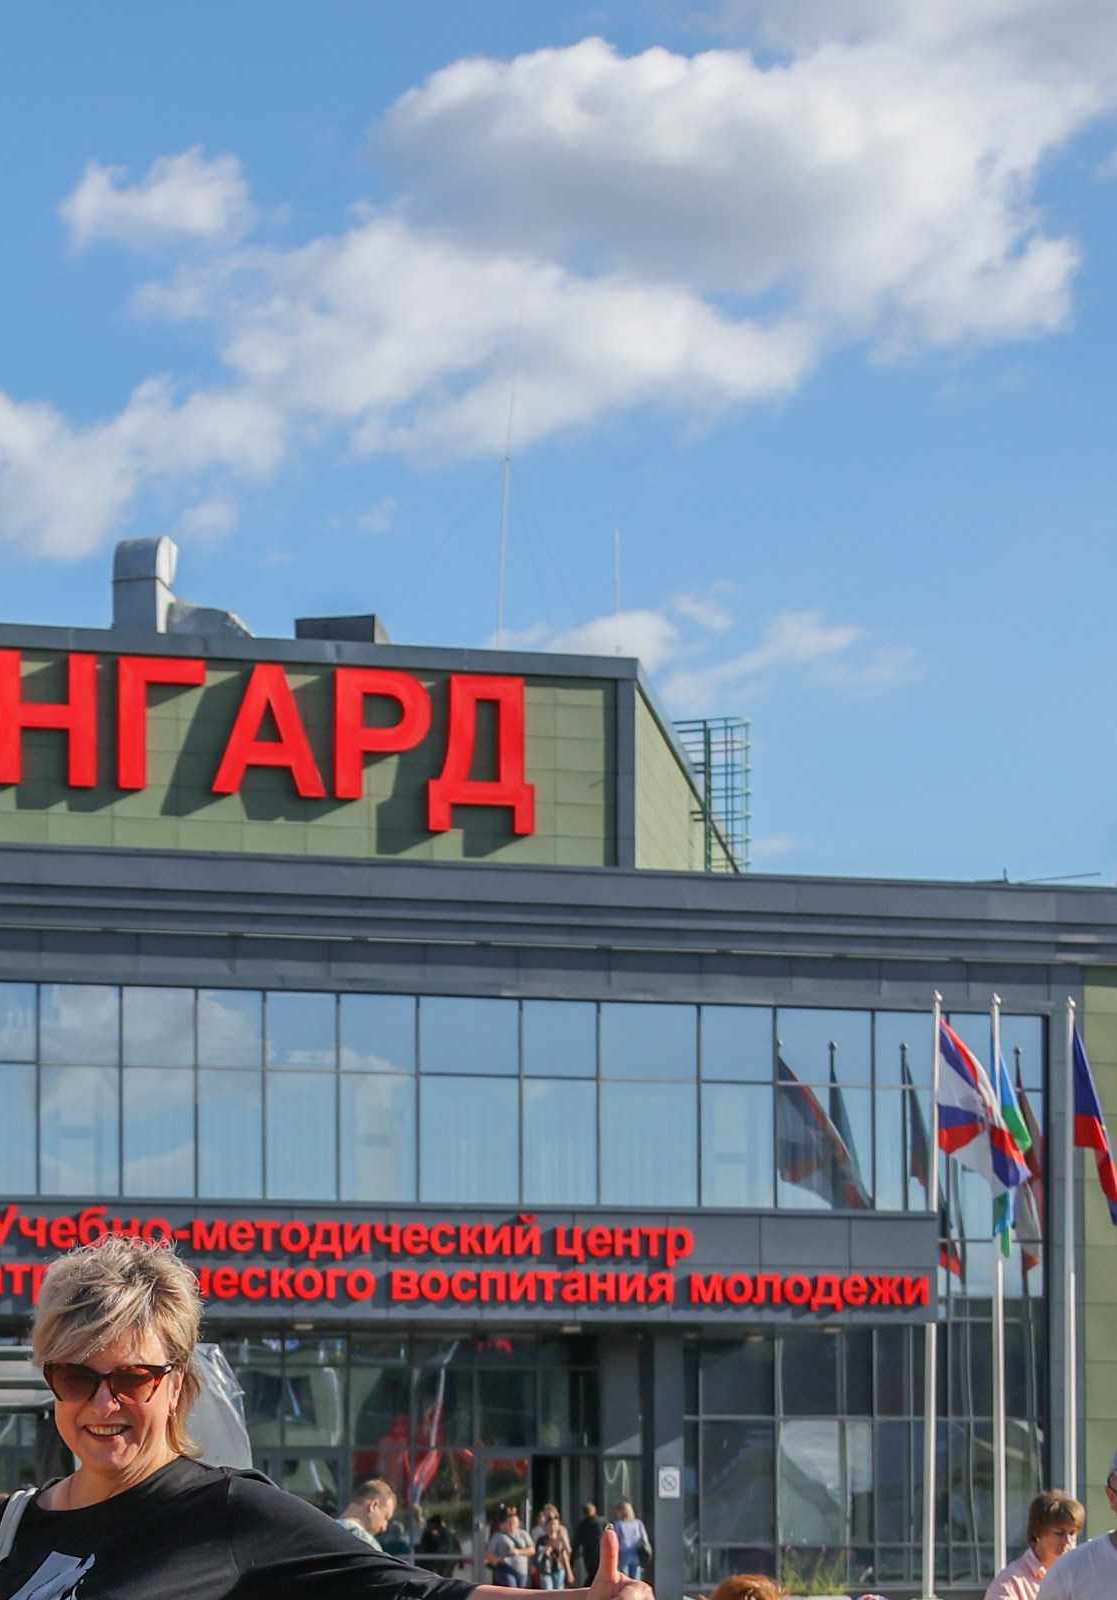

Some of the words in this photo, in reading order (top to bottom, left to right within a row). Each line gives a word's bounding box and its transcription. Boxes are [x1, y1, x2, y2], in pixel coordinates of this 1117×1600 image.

[556, 1225, 694, 1268] центр
[391, 1270, 675, 1304] воспитания
[690, 1273, 929, 1312] молодежи
